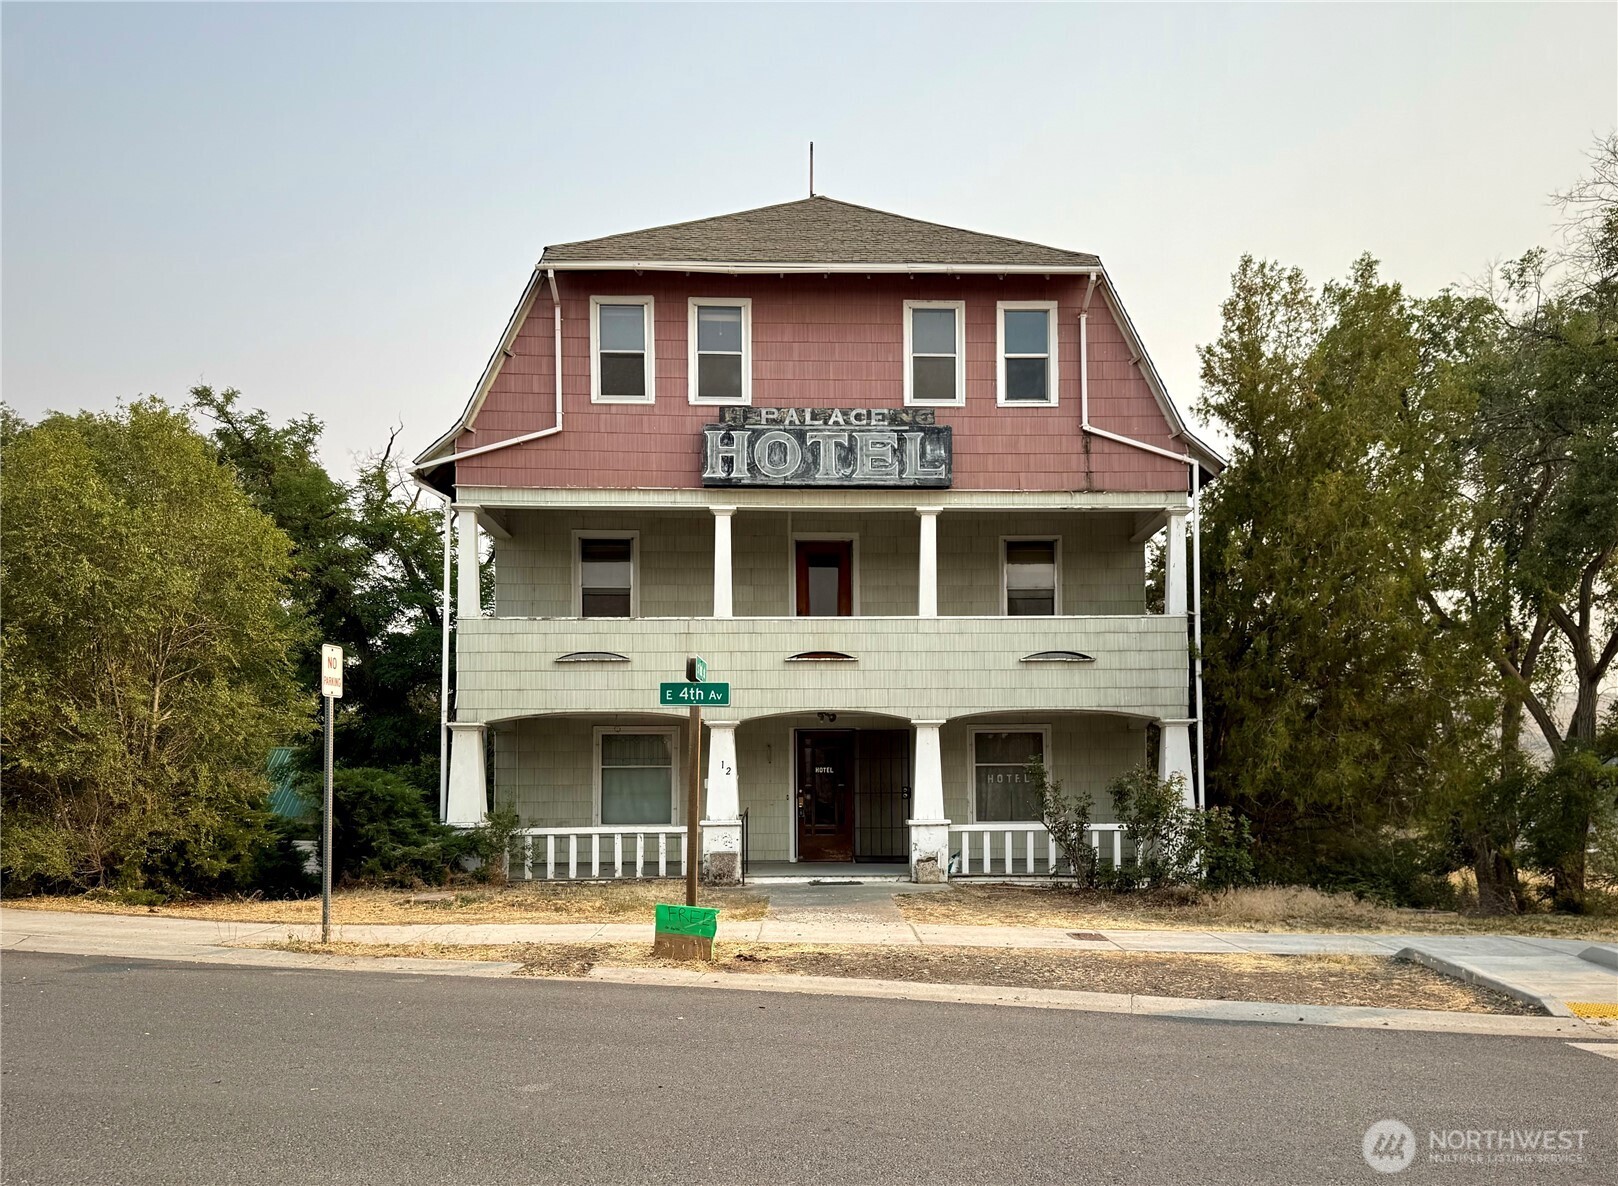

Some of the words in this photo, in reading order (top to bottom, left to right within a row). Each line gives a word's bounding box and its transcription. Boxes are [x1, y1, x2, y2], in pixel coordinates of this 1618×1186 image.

[760, 408, 890, 426] PALACE
[702, 430, 946, 478] HOTEL
[327, 656, 338, 670] NO
[666, 689, 673, 700] E
[679, 687, 704, 700] 4th
[708, 690, 723, 700] Av
[815, 766, 835, 774] HOTEL
[987, 774, 1030, 783] HOTEL
[667, 905, 711, 927] FREE
